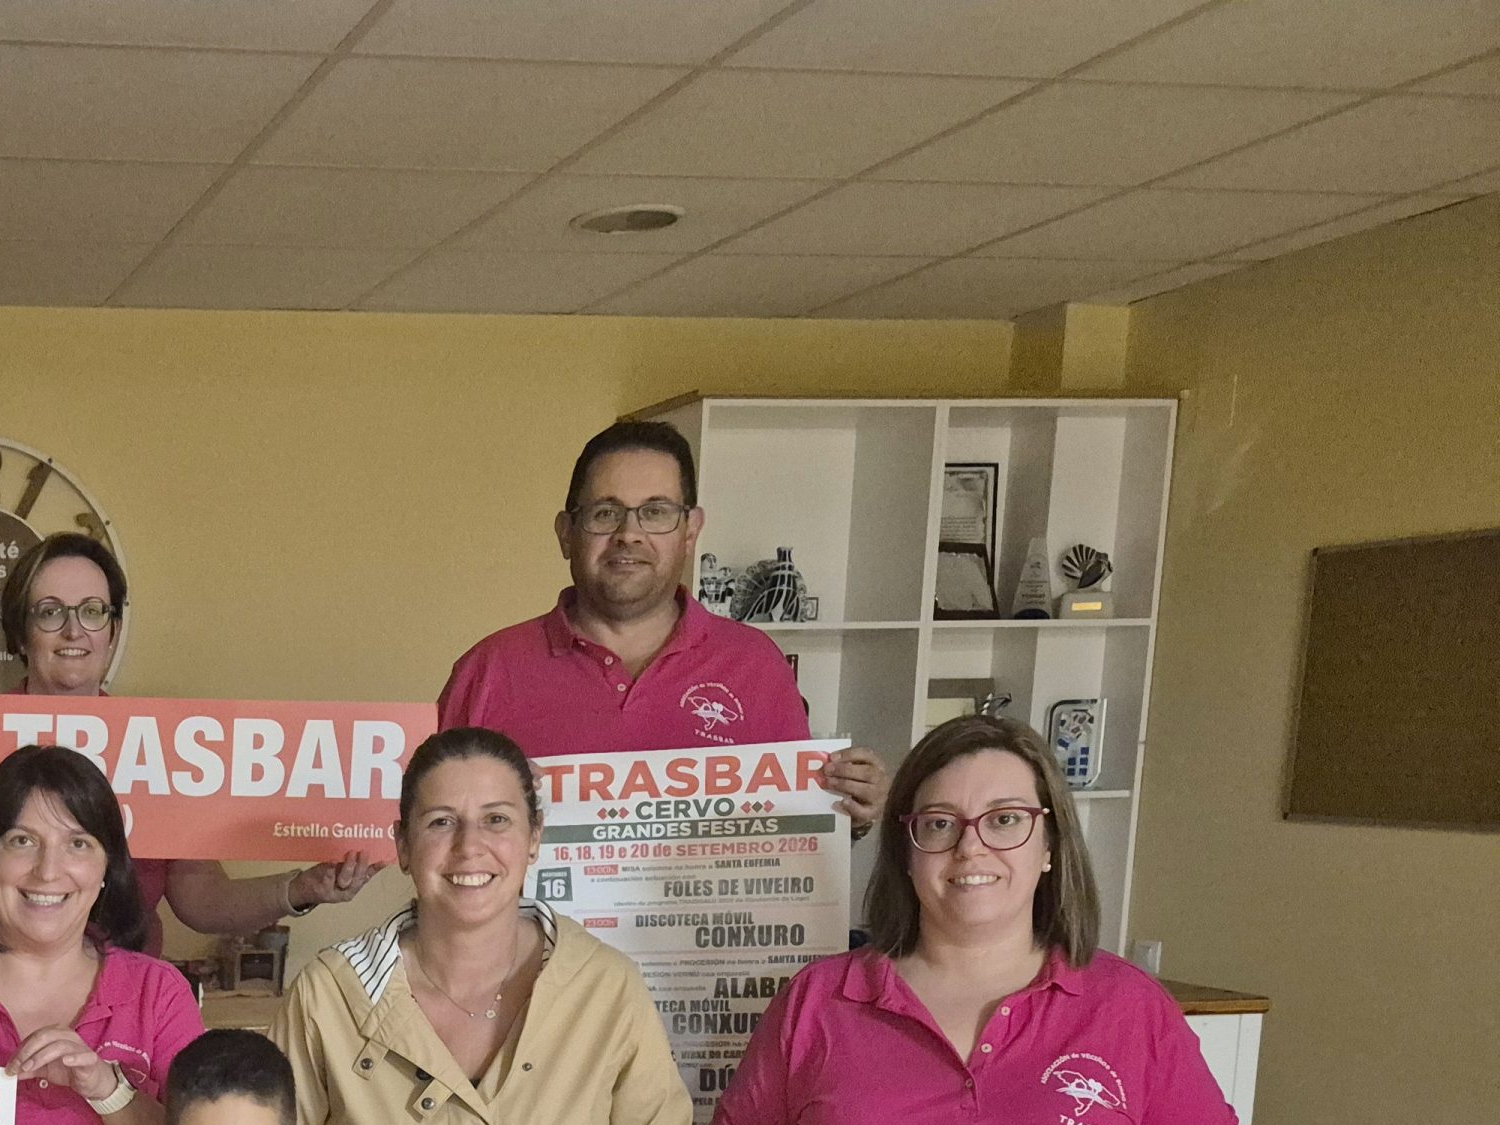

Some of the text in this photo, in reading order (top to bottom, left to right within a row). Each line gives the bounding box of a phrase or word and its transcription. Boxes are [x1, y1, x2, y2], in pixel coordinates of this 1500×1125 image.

[635, 798, 735, 820] CERVO
[274, 822, 383, 838] Estrella Galicia
[593, 819, 778, 840] GRANDES FESTAS
[599, 844, 615, 858] 19
[618, 844, 627, 858] e
[630, 842, 649, 858] 20
[652, 842, 672, 857] de
[676, 840, 774, 856] SETEMBRO
[778, 837, 818, 852] 2026
[542, 880, 565, 899] 16
[664, 876, 814, 897] FOLES DE VIVEIRO
[635, 911, 753, 928] DISCOTECA MÓVIL
[696, 925, 805, 948] CONXURO
